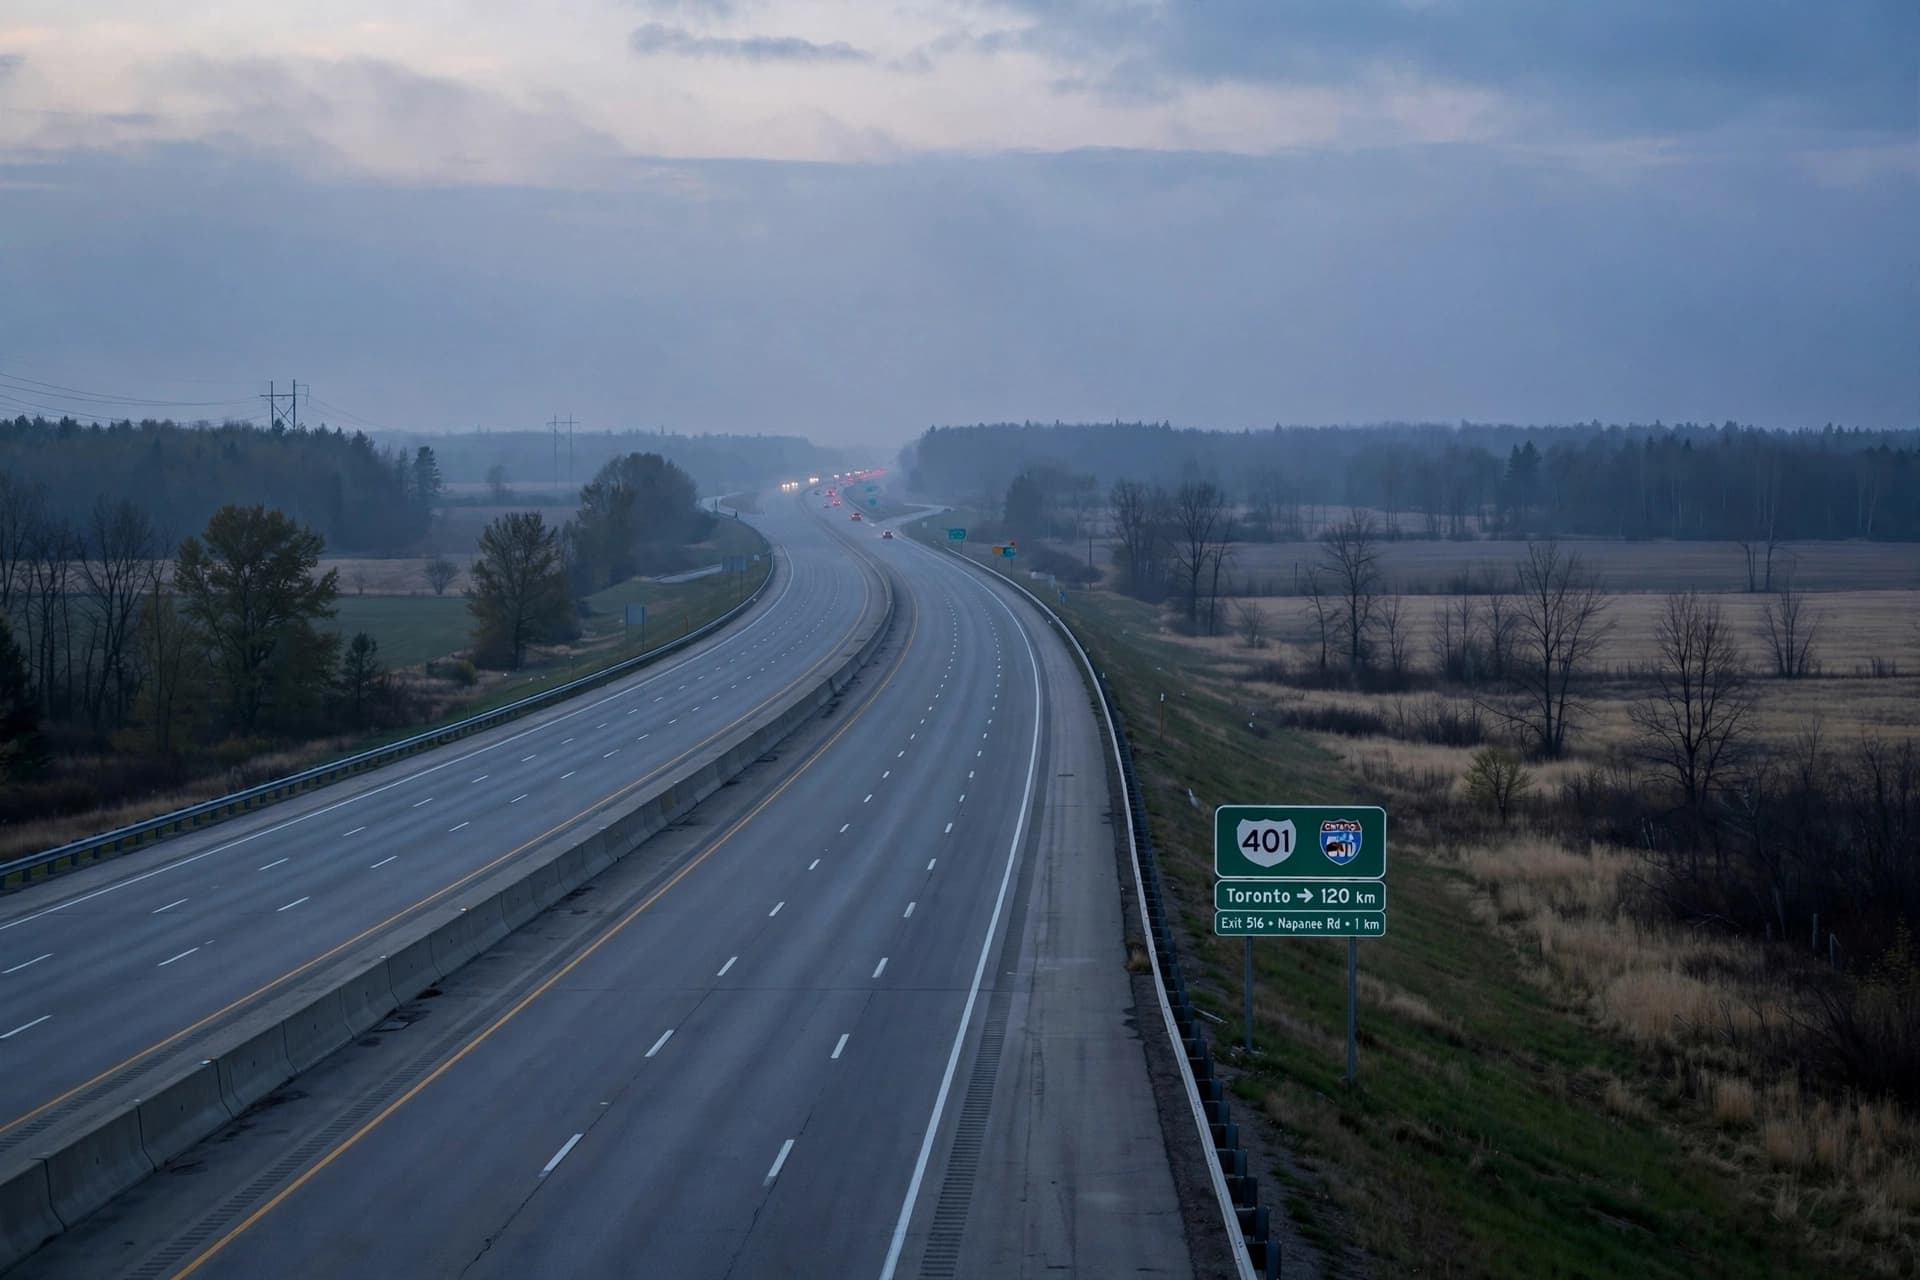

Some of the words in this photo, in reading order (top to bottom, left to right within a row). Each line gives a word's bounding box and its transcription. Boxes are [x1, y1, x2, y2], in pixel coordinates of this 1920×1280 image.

[1242, 829, 1289, 853] 401
[1226, 888, 1291, 903] Toronto
[1322, 888, 1349, 904] 120
[1356, 892, 1375, 904] km
[1221, 917, 1242, 929] Exit
[1247, 917, 1264, 929] 516
[1278, 918, 1322, 931] Napanee
[1327, 918, 1340, 929] Rd
[1364, 919, 1379, 930] km
